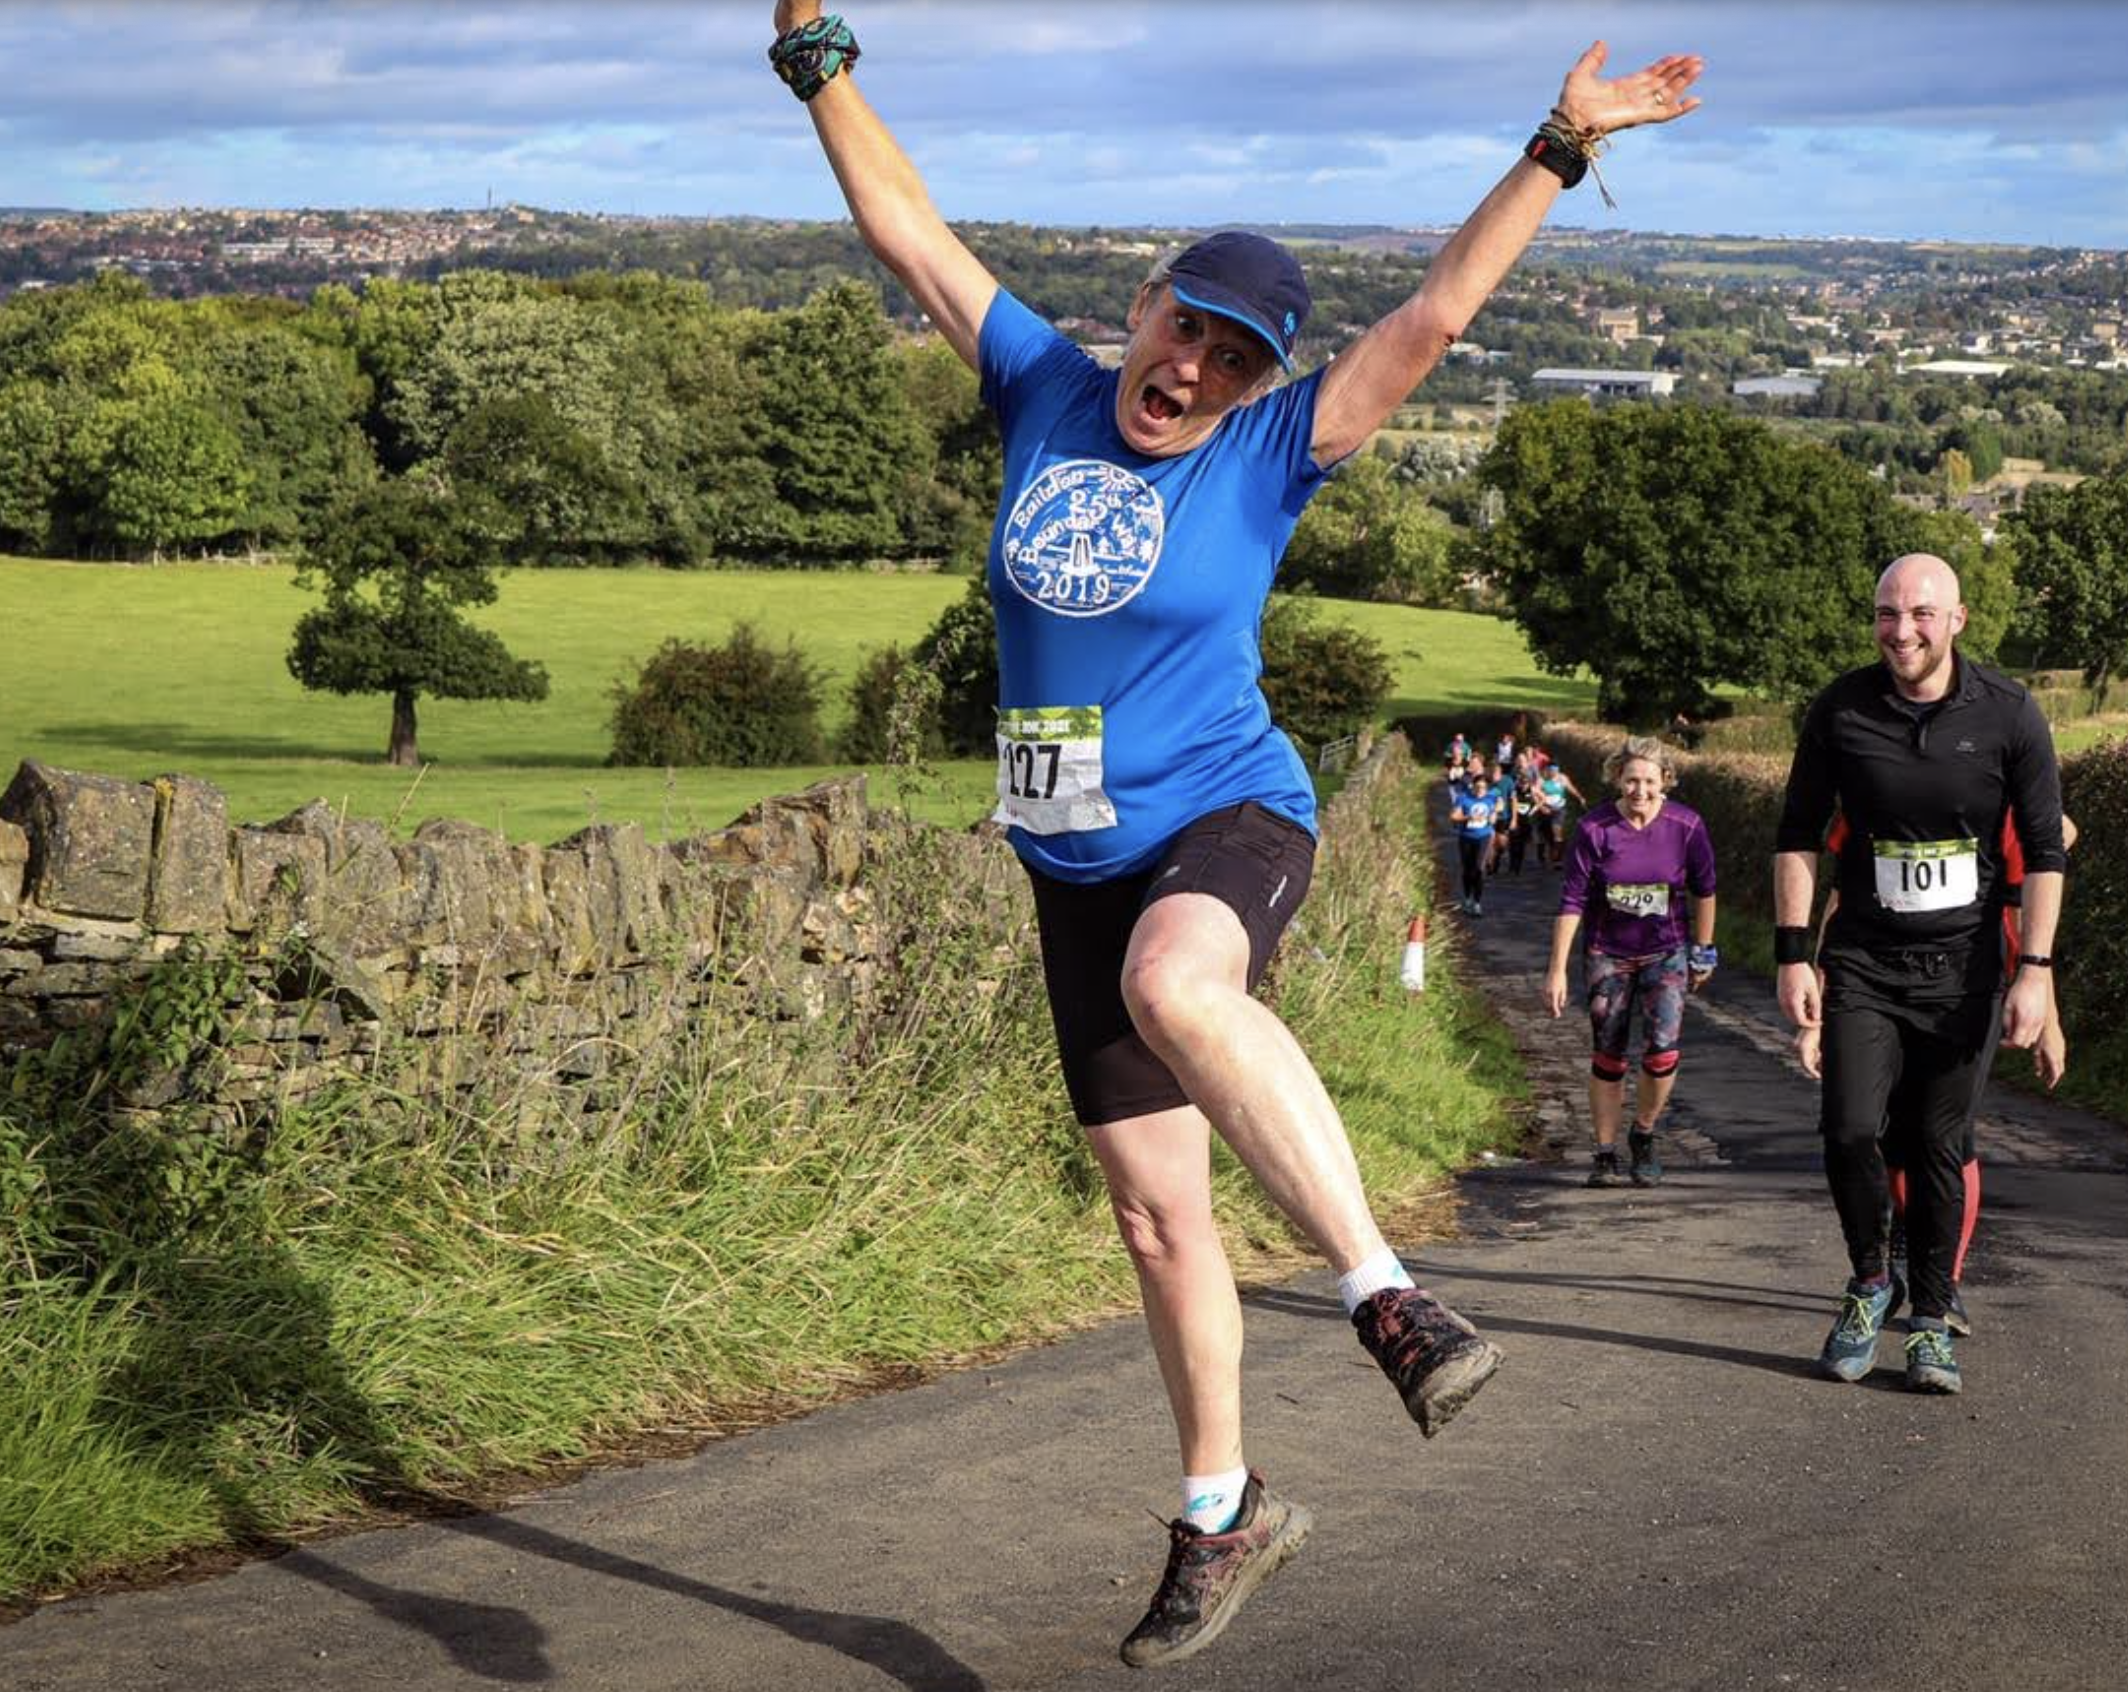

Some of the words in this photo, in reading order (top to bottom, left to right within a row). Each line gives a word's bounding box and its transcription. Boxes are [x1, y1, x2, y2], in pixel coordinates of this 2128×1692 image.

[1014, 470, 1085, 529] Baildon
[1069, 490, 1122, 521] 25th
[1035, 571, 1110, 605] 2019
[1004, 742, 1062, 799] 227
[1902, 859, 1947, 891] 101
